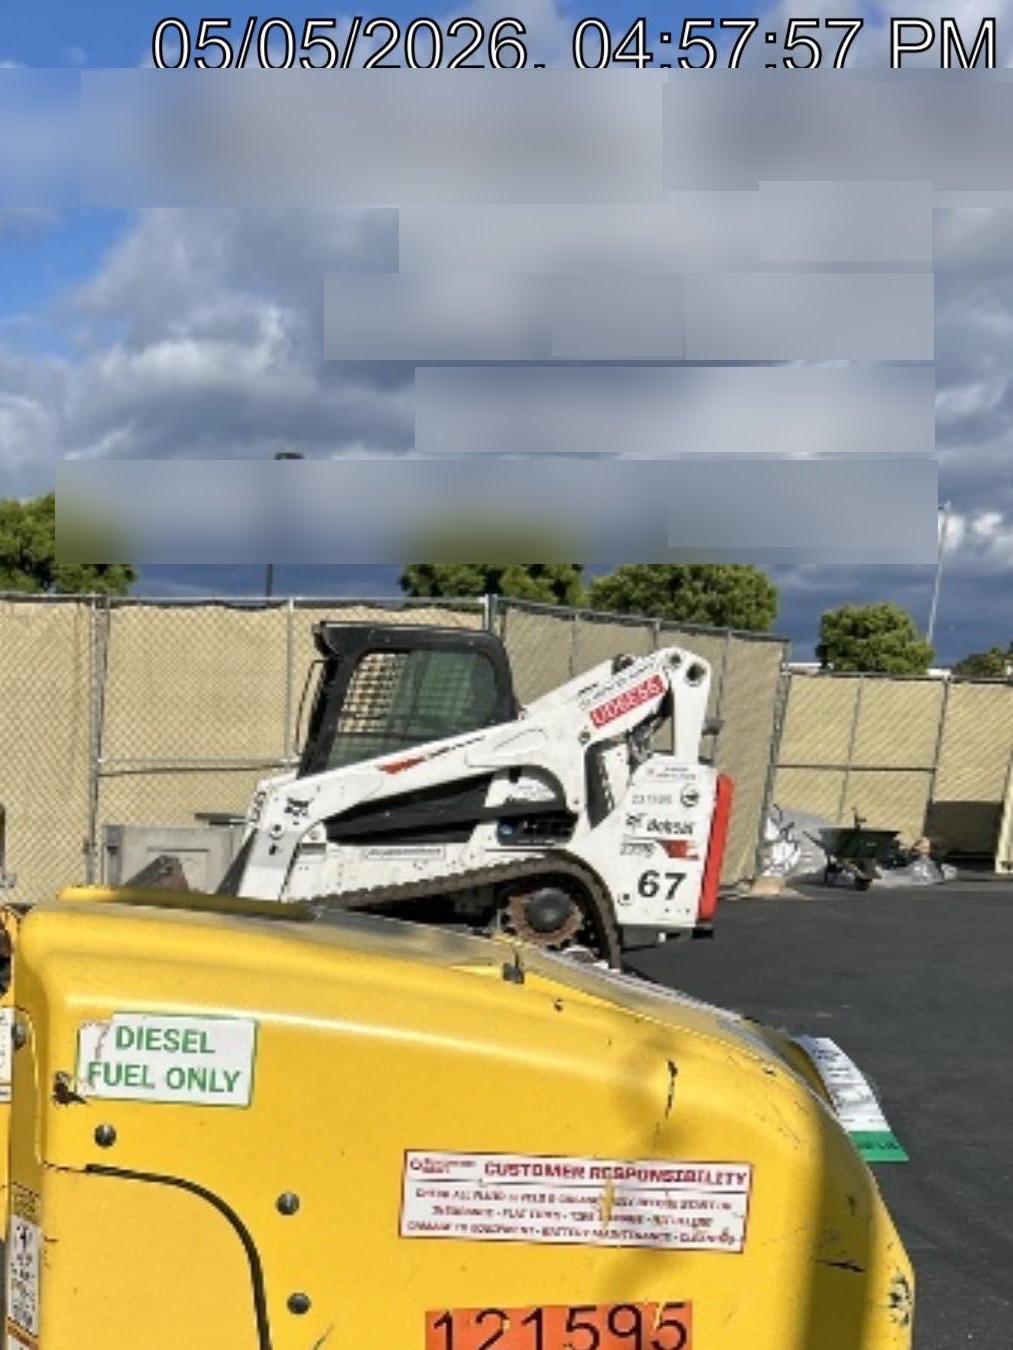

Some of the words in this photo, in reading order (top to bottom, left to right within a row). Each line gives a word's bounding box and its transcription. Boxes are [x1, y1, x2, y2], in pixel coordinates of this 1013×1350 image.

[638, 870, 686, 900] 67
[115, 1025, 215, 1054] DIESEL
[87, 1061, 155, 1089] FUEL
[166, 1066, 241, 1092] ONLY
[484, 1161, 585, 1179] CUSTOMER
[589, 1166, 747, 1185] RESPONSIBILITY
